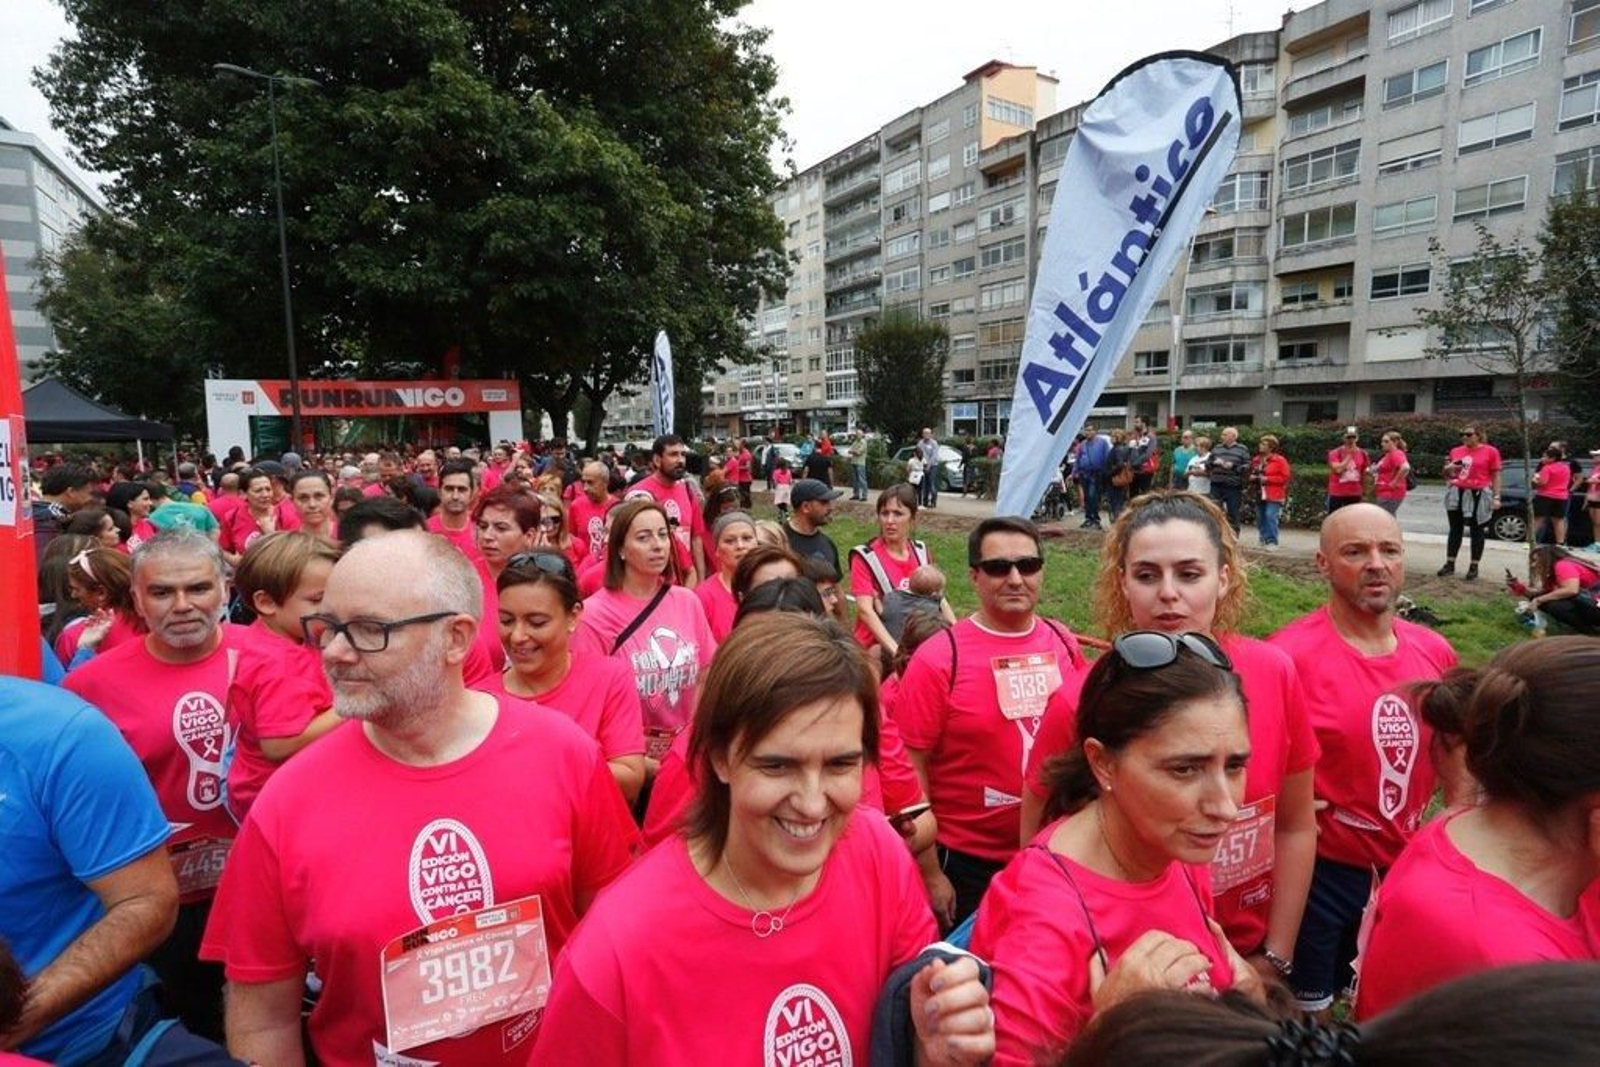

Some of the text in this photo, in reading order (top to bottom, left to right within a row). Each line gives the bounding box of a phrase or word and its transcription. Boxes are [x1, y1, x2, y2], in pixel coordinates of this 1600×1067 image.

[1022, 96, 1214, 426] Atlántico
[1008, 673, 1048, 699] 5138
[186, 699, 205, 711] VI
[1383, 703, 1399, 716] VI
[182, 713, 219, 728] VIGO
[1380, 722, 1411, 733] VIGO
[429, 832, 457, 854] VI
[421, 862, 476, 886] VIGO
[421, 878, 482, 898] CONTRA EL
[419, 939, 519, 1005] 3982
[782, 998, 813, 1028] VI
[776, 1031, 835, 1067] VIGO
